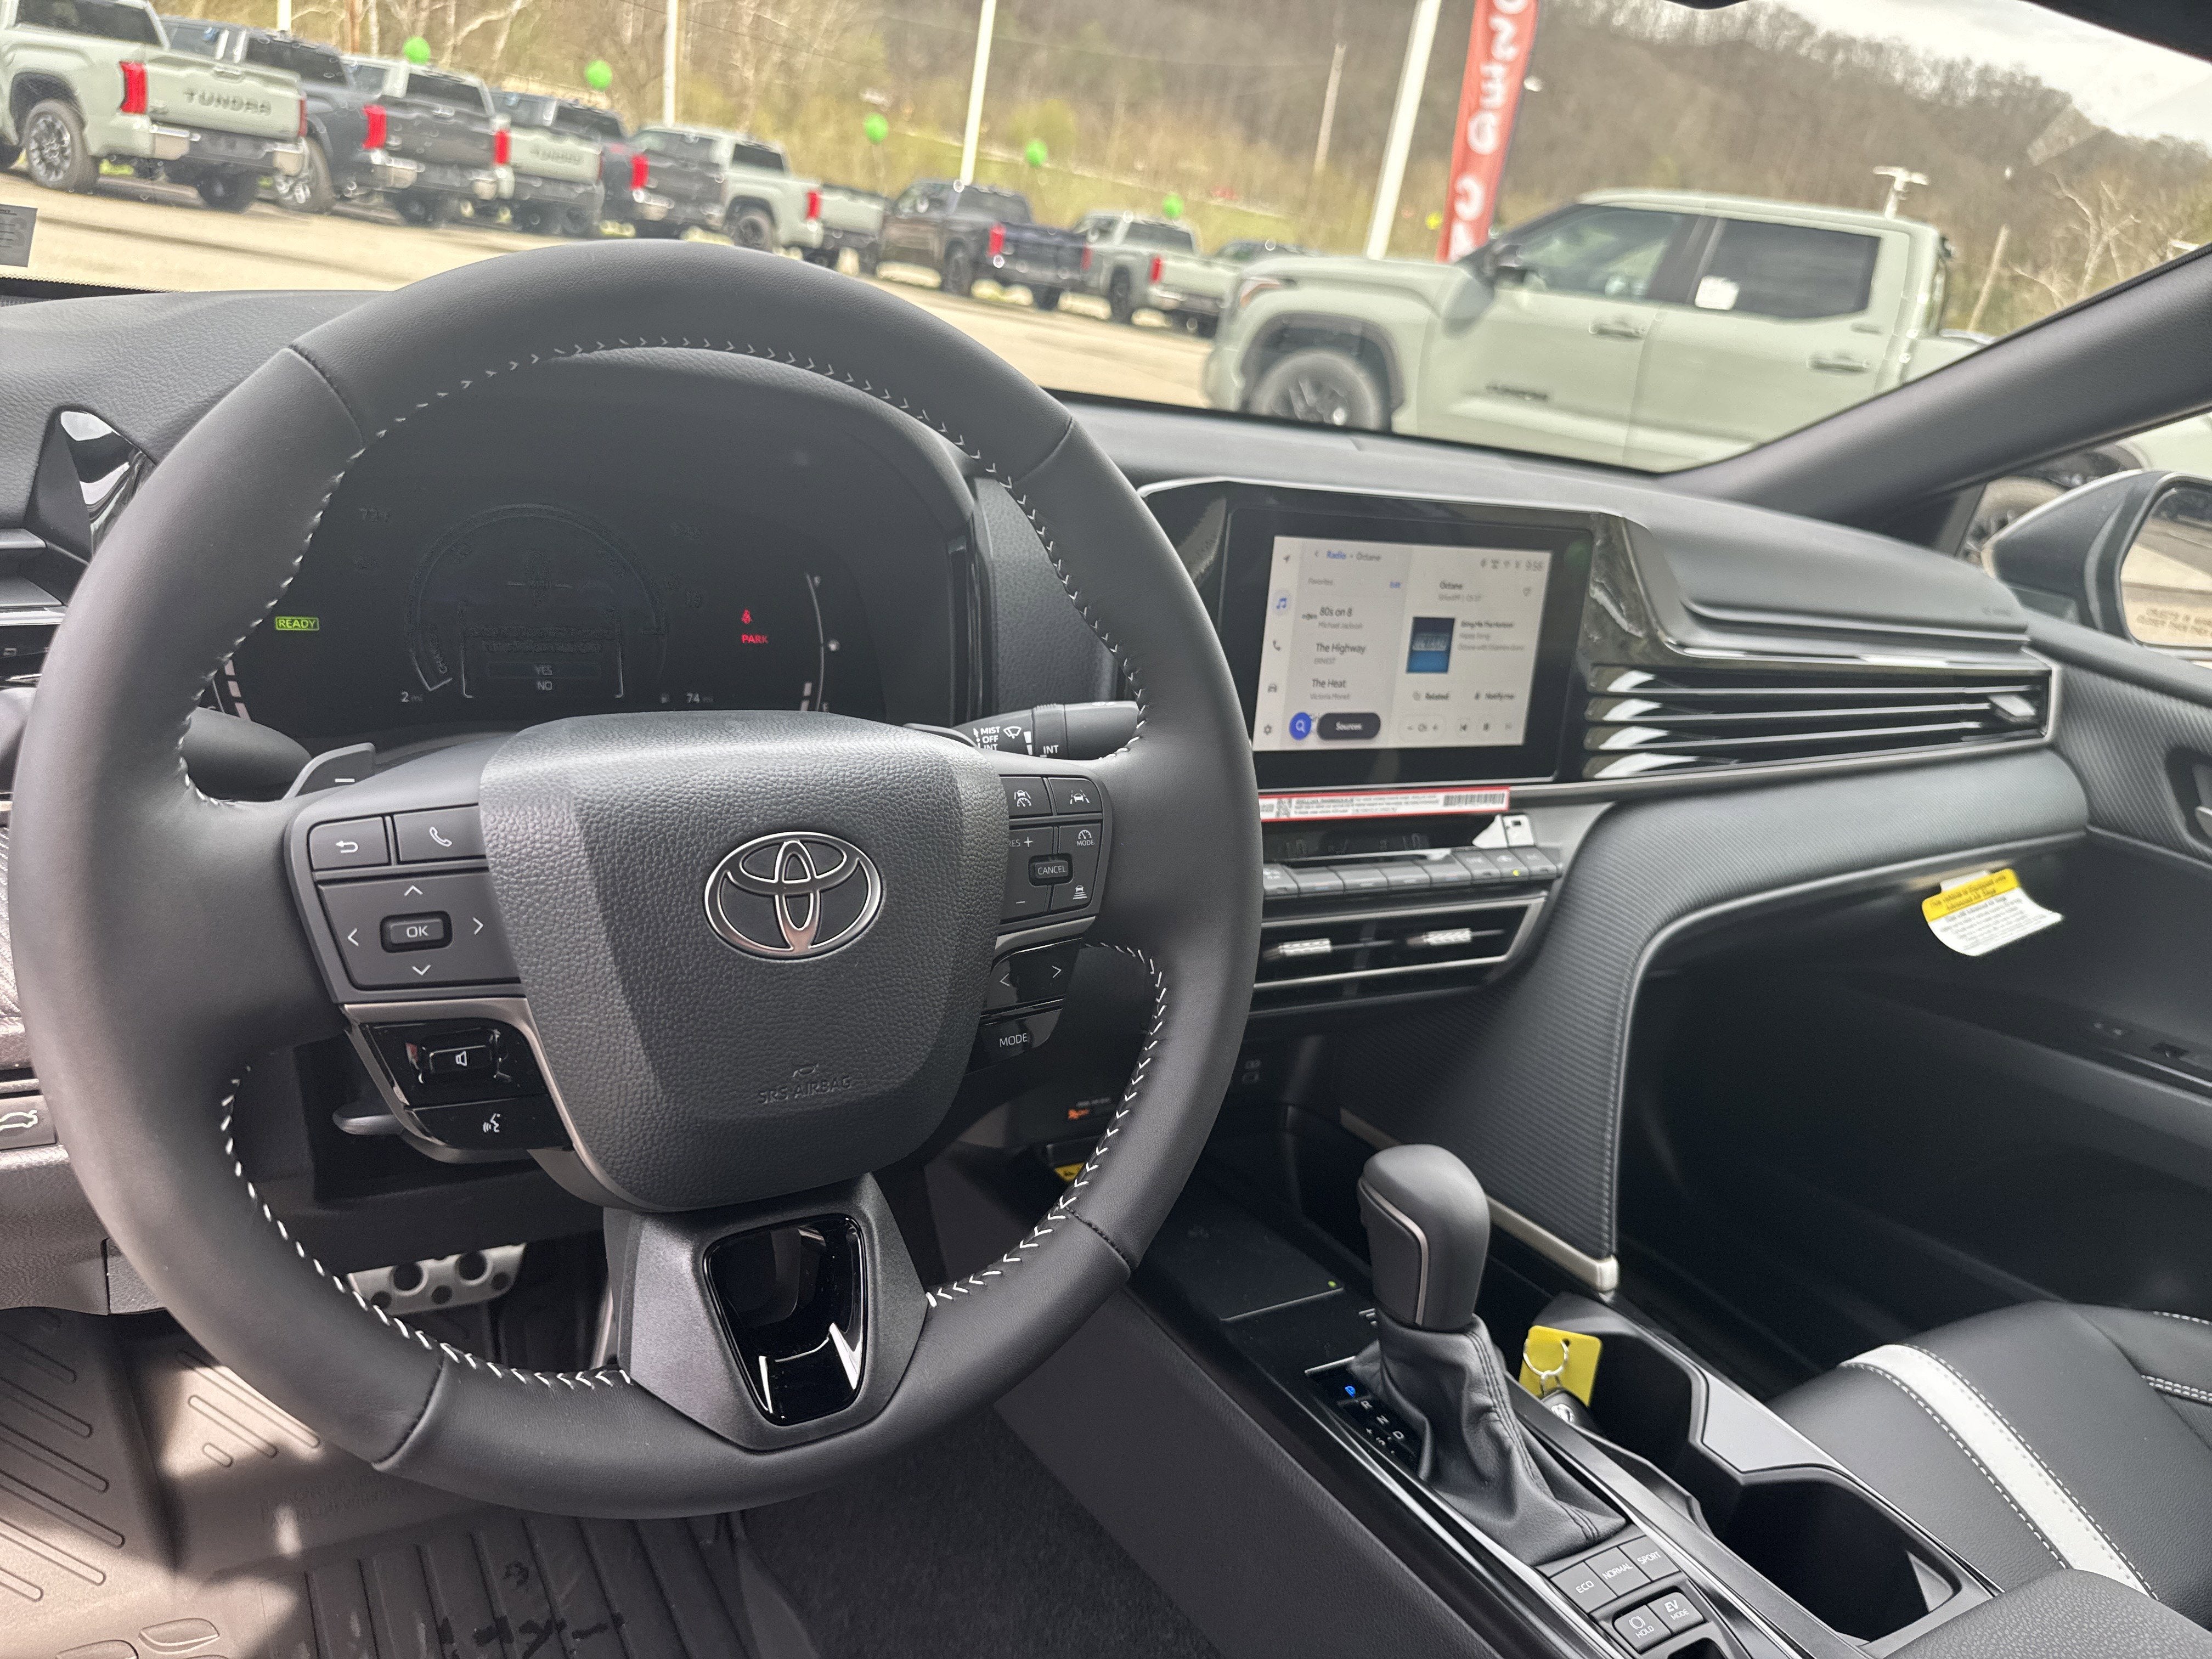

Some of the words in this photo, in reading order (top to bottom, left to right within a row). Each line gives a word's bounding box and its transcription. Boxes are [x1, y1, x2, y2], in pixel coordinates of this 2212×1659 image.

[184, 87, 272, 116] TUNDRA
[1319, 606, 1334, 617] 80s
[1347, 607, 1353, 617] 8
[278, 619, 315, 628] READY
[741, 634, 768, 644] PARK
[1316, 642, 1330, 652] The
[1331, 644, 1365, 654] Highway
[534, 664, 553, 675] YES
[538, 681, 552, 691] NO
[1312, 678, 1326, 688] The
[1328, 679, 1346, 688] Heat
[401, 691, 409, 702] 2
[686, 692, 700, 703] 74
[980, 726, 1001, 735] MIST
[1336, 721, 1363, 731] Sources
[982, 735, 998, 743] OFF
[1043, 744, 1059, 754] INT
[1037, 865, 1066, 875] CANCEL
[406, 925, 428, 938] OK
[1000, 1032, 1028, 1047] MODE
[794, 1076, 852, 1098] AIRBAG
[1345, 1385, 1356, 1398] P
[1361, 1401, 1373, 1410] R
[1376, 1414, 1390, 1425] N
[1392, 1430, 1404, 1440] D
[1637, 1550, 1661, 1565] SPORT
[1602, 1562, 1633, 1580] NORMAL
[1576, 1580, 1594, 1594] ECO
[1664, 1599, 1678, 1612] EV
[1671, 1608, 1690, 1621] MODE
[1635, 1625, 1655, 1639] HOLD
